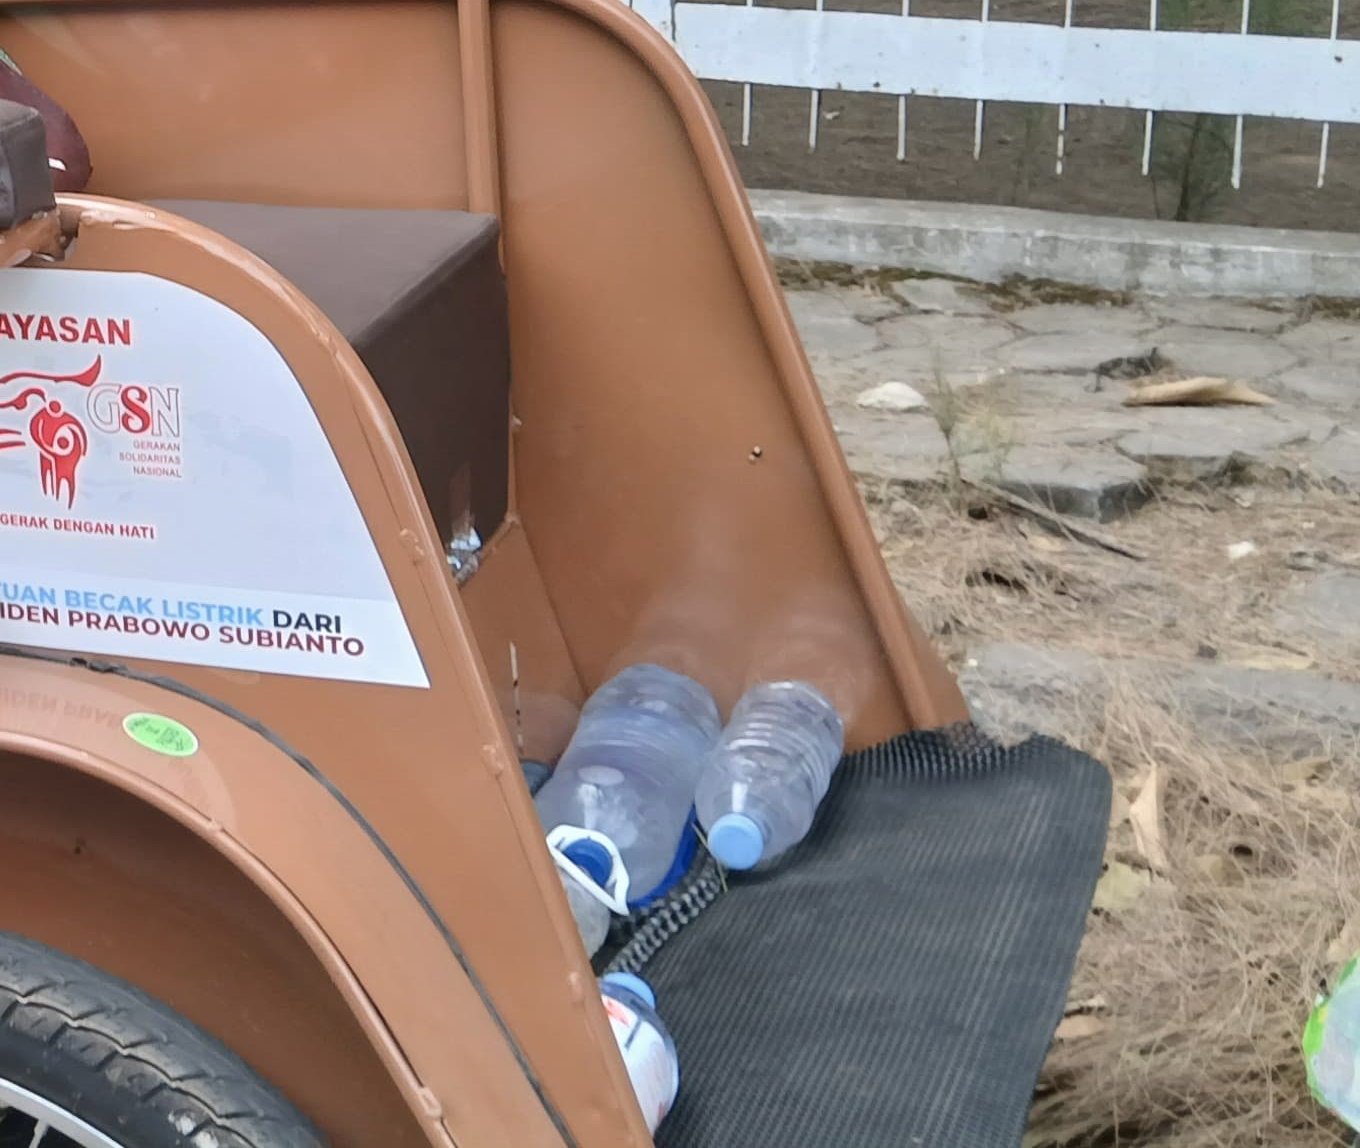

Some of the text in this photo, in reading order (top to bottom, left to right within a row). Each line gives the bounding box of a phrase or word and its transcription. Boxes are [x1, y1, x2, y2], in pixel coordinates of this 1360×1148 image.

[86, 382, 180, 438] GSN
[133, 439, 181, 452] GERAKAN
[119, 452, 181, 465] SOLIDARITAS
[133, 465, 182, 478] NASIONAL
[53, 518, 115, 536] DENGAN
[119, 524, 155, 540] HATI
[64, 588, 155, 615] BECAK
[162, 598, 264, 627] LISTRIK
[272, 609, 342, 634] DARI
[68, 609, 210, 642] PRABOWO
[219, 625, 365, 657] SUBIANTO
